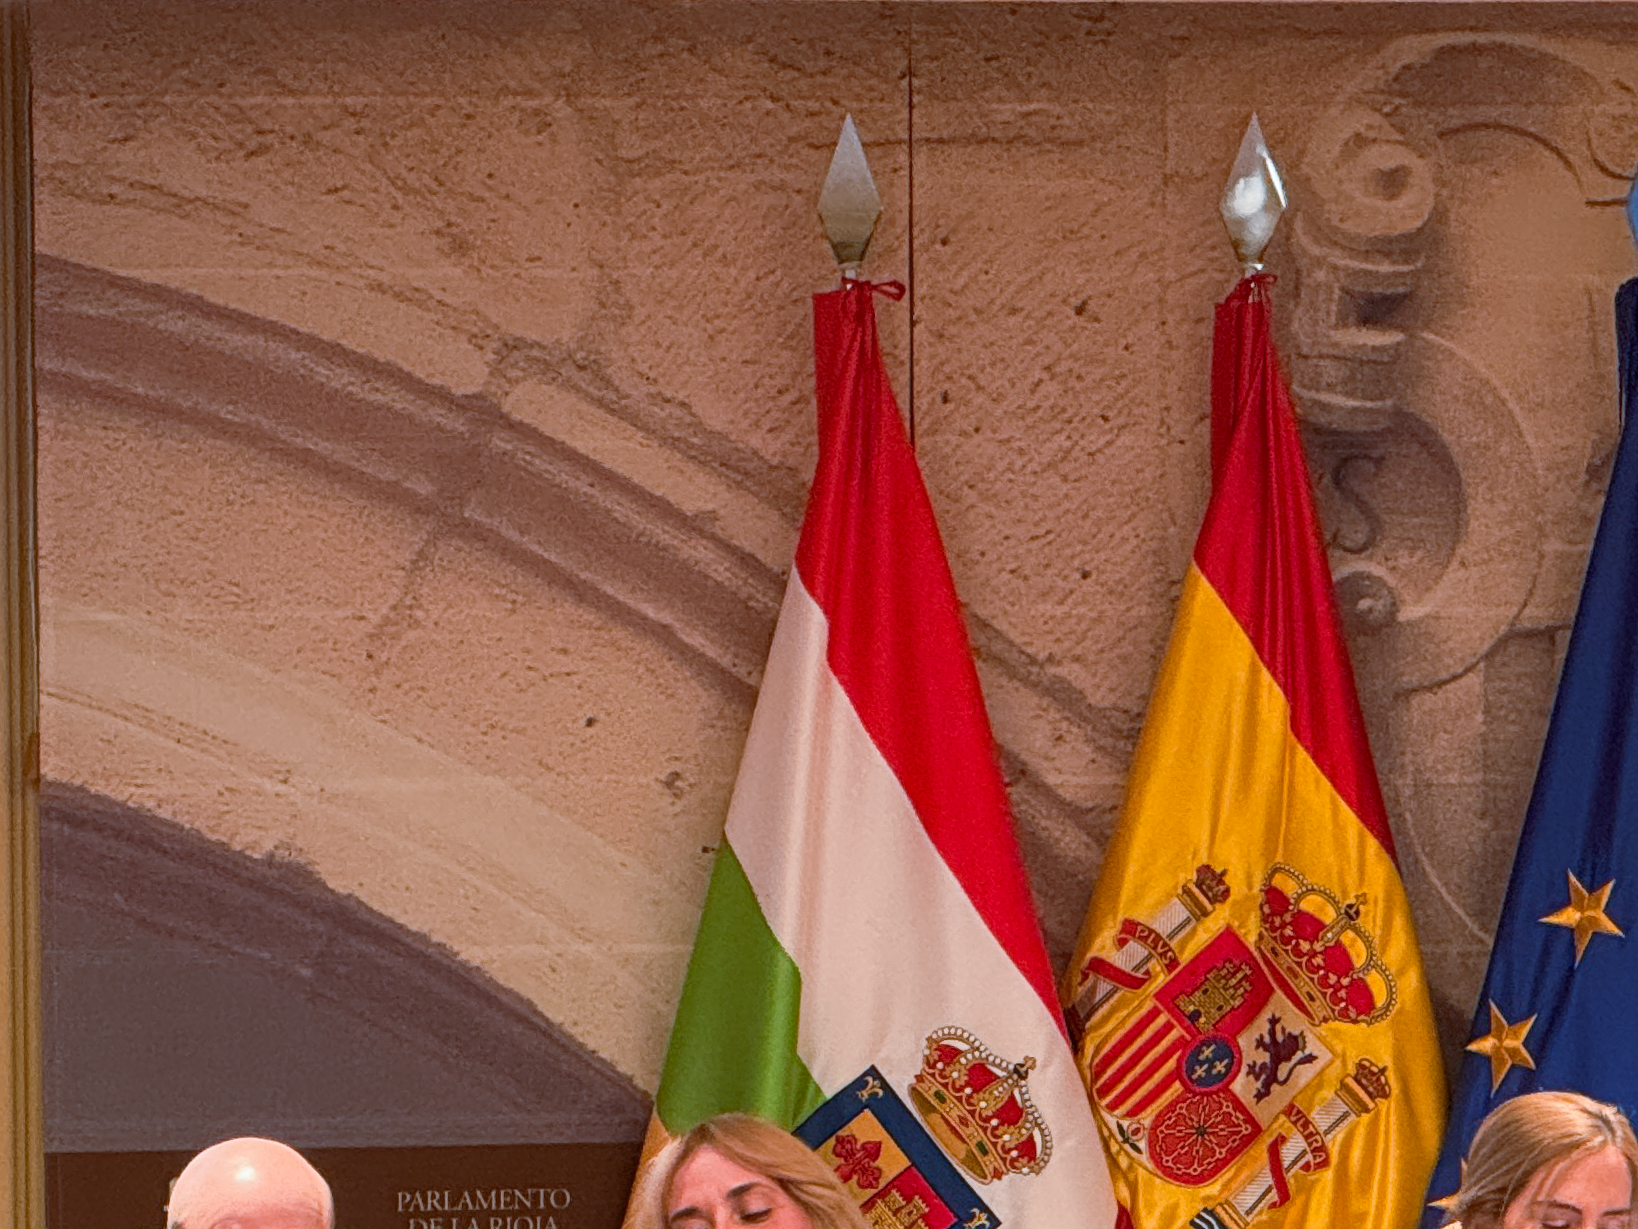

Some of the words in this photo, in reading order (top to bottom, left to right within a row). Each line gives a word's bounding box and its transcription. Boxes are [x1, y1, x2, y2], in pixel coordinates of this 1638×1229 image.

[1135, 925, 1175, 965] PLVS
[1289, 1106, 1327, 1164] VLTRA
[397, 1188, 572, 1212] PARLAMENTO
